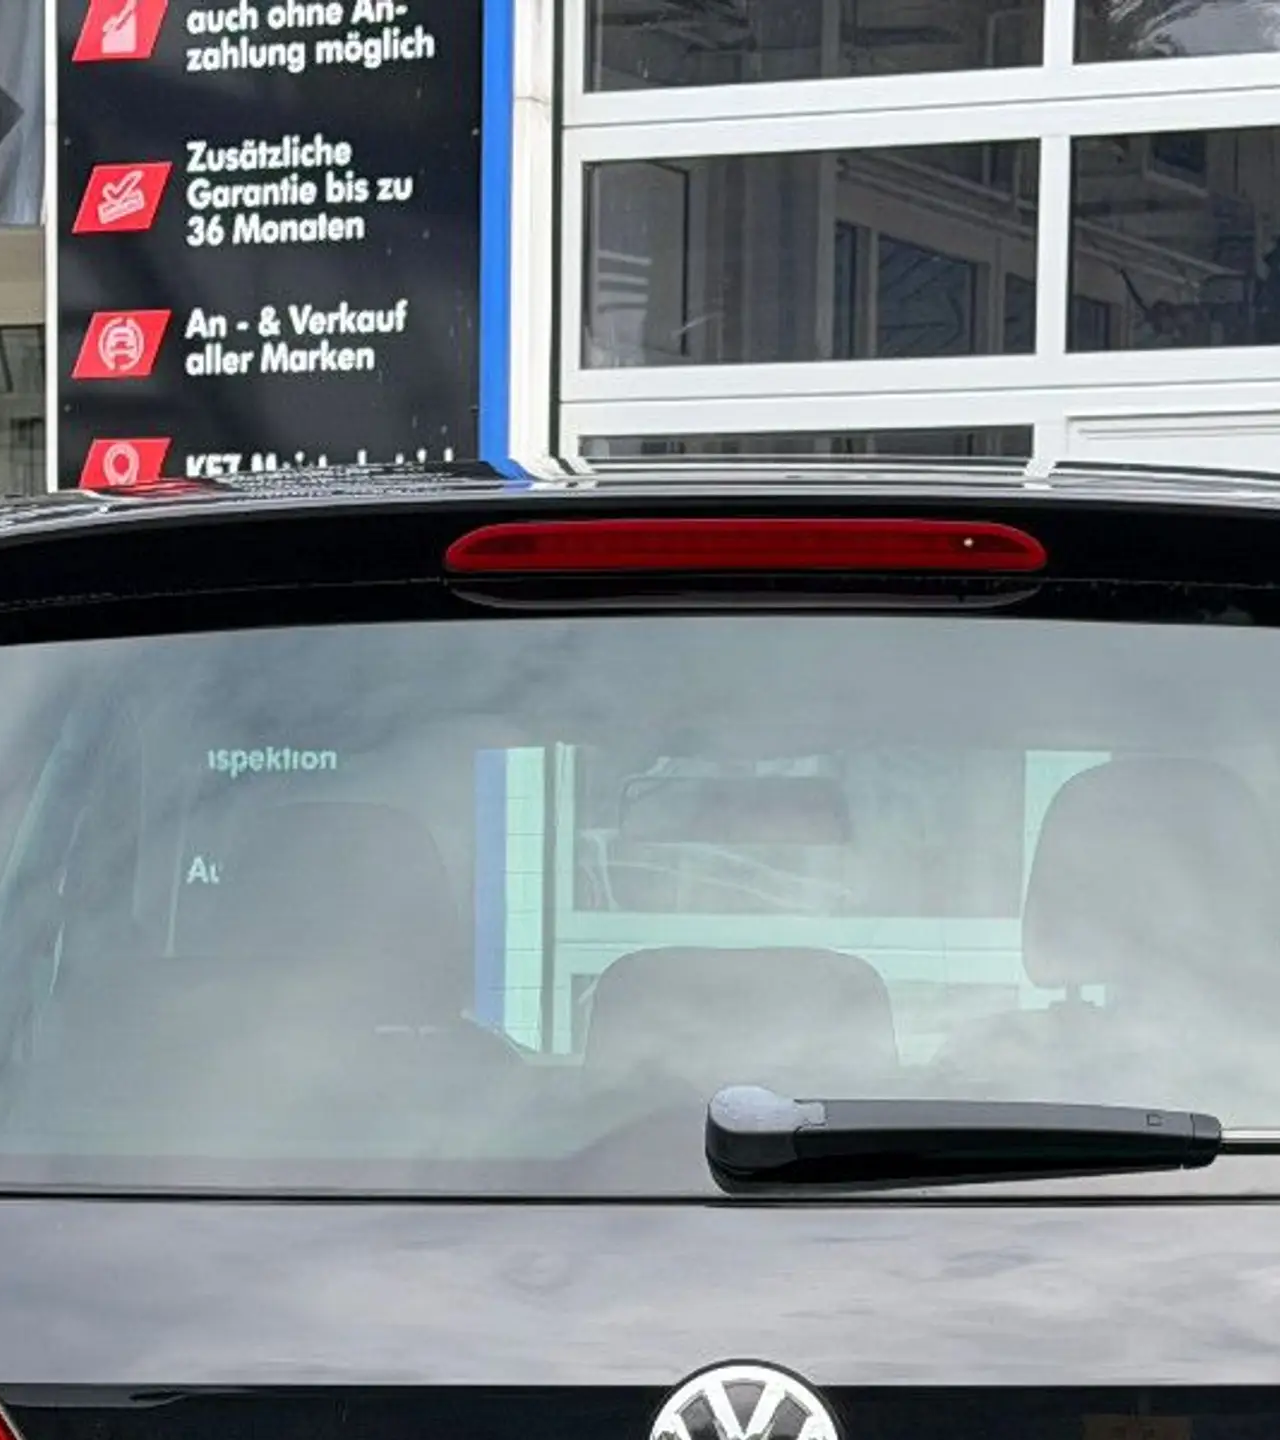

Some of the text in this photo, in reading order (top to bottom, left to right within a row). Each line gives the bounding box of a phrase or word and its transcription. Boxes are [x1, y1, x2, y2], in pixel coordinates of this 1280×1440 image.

[186, 0, 408, 34] auch ohne An-
[186, 25, 435, 73] zahlung möglich
[186, 133, 352, 172] Zusätzliche
[186, 170, 413, 209] Garantie bis zu
[186, 212, 365, 246] 36 Monaten
[185, 307, 227, 339] An
[258, 305, 281, 337] &
[288, 299, 408, 335] Verkauf
[185, 339, 374, 375] aller Marken
